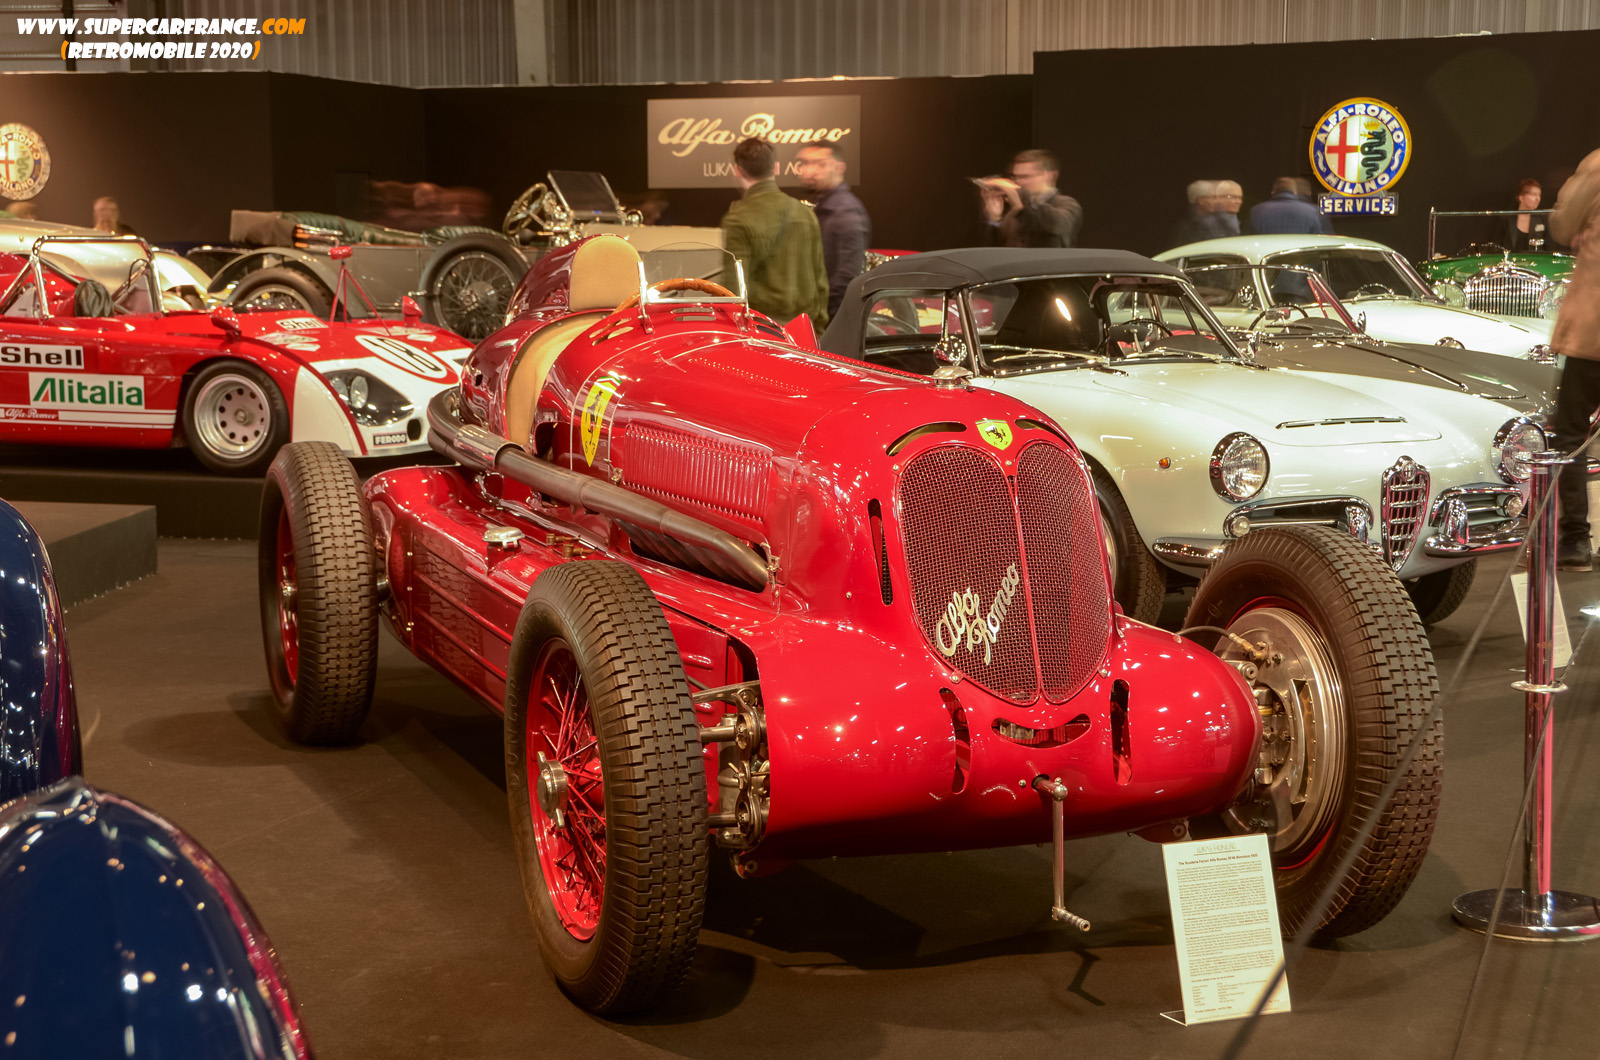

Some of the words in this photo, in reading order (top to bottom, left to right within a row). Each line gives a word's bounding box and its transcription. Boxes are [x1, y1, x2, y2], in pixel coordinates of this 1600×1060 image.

[1316, 103, 1404, 144] ALFA-ROMEO
[658, 118, 735, 157] Alfa
[737, 112, 851, 144] Romeo
[1325, 173, 1390, 194] MILANO
[1324, 198, 1391, 213] SERVICE
[280, 318, 324, 329] Shell
[1, 346, 82, 366] Shell
[32, 377, 143, 406] Alitalia
[5, 408, 27, 420] Alfa
[27, 408, 57, 419] Romeo
[375, 433, 406, 445] FERODO
[936, 587, 975, 656] Alfa
[971, 563, 1019, 666] Romeo
